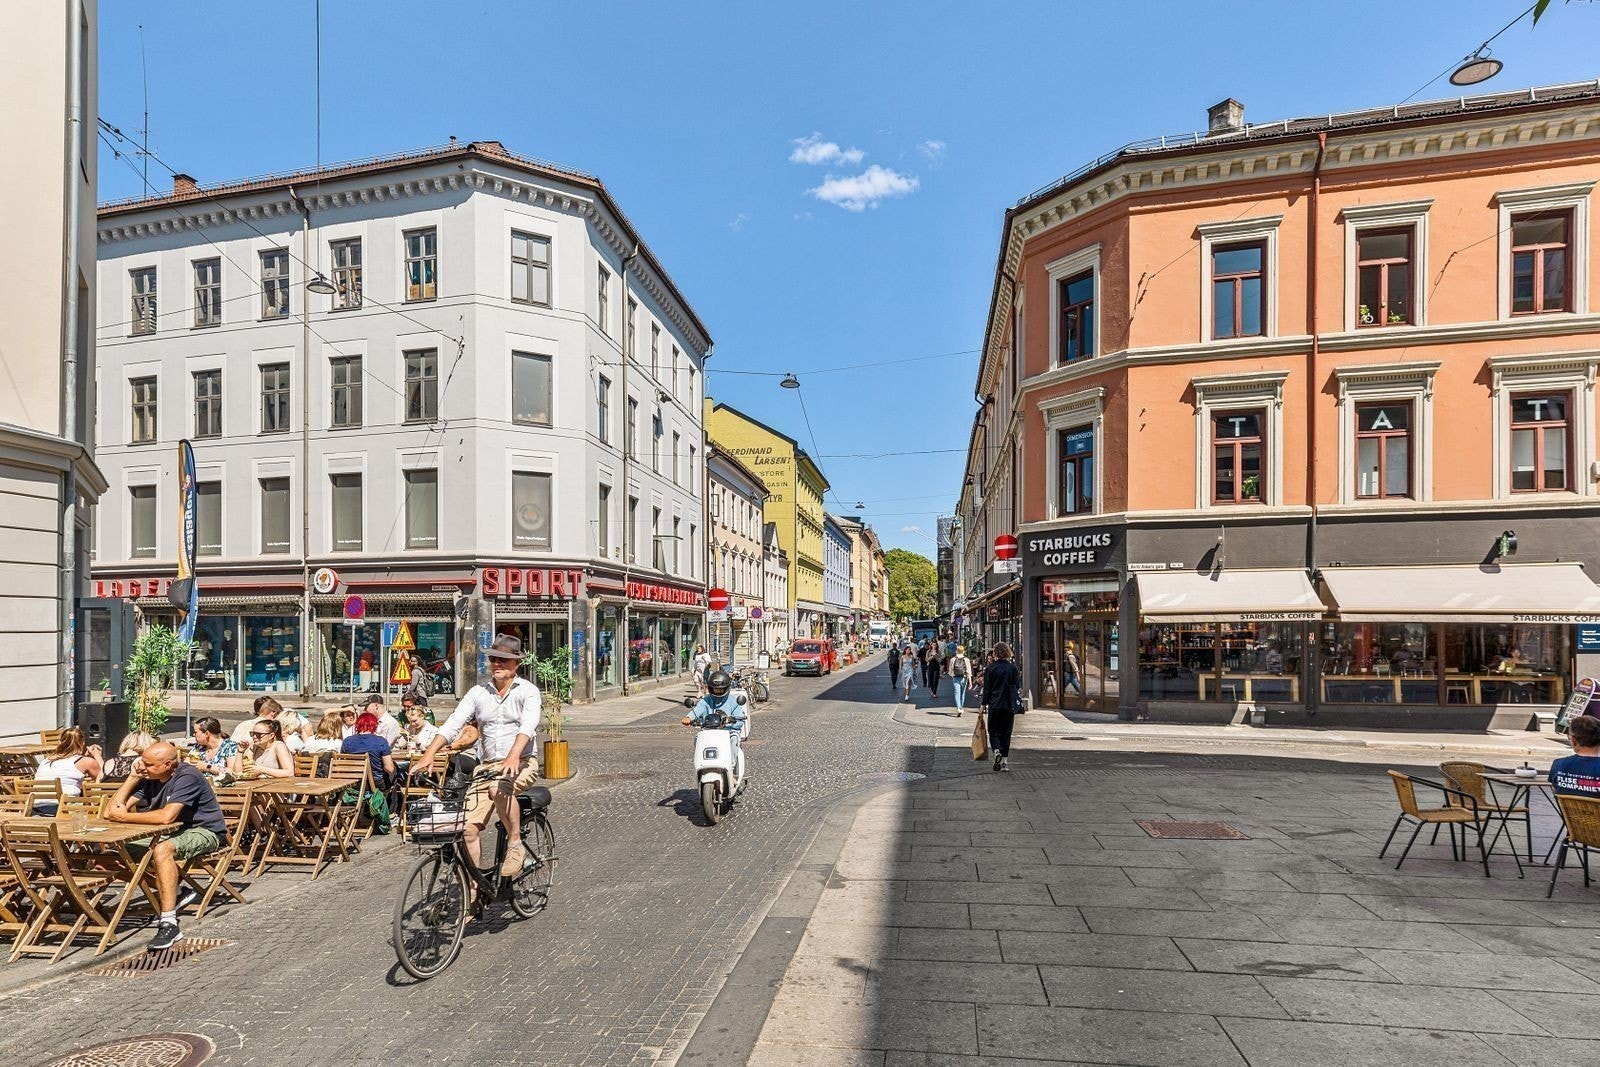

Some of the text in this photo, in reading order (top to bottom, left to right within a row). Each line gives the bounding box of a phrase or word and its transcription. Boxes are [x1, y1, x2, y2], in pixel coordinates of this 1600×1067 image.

[1228, 399, 1548, 437] T A T
[1029, 533, 1112, 552] STARBUCKS
[1043, 550, 1095, 566] COFFEE
[482, 566, 584, 597] SPORT
[1557, 775, 1578, 784] FLISE
